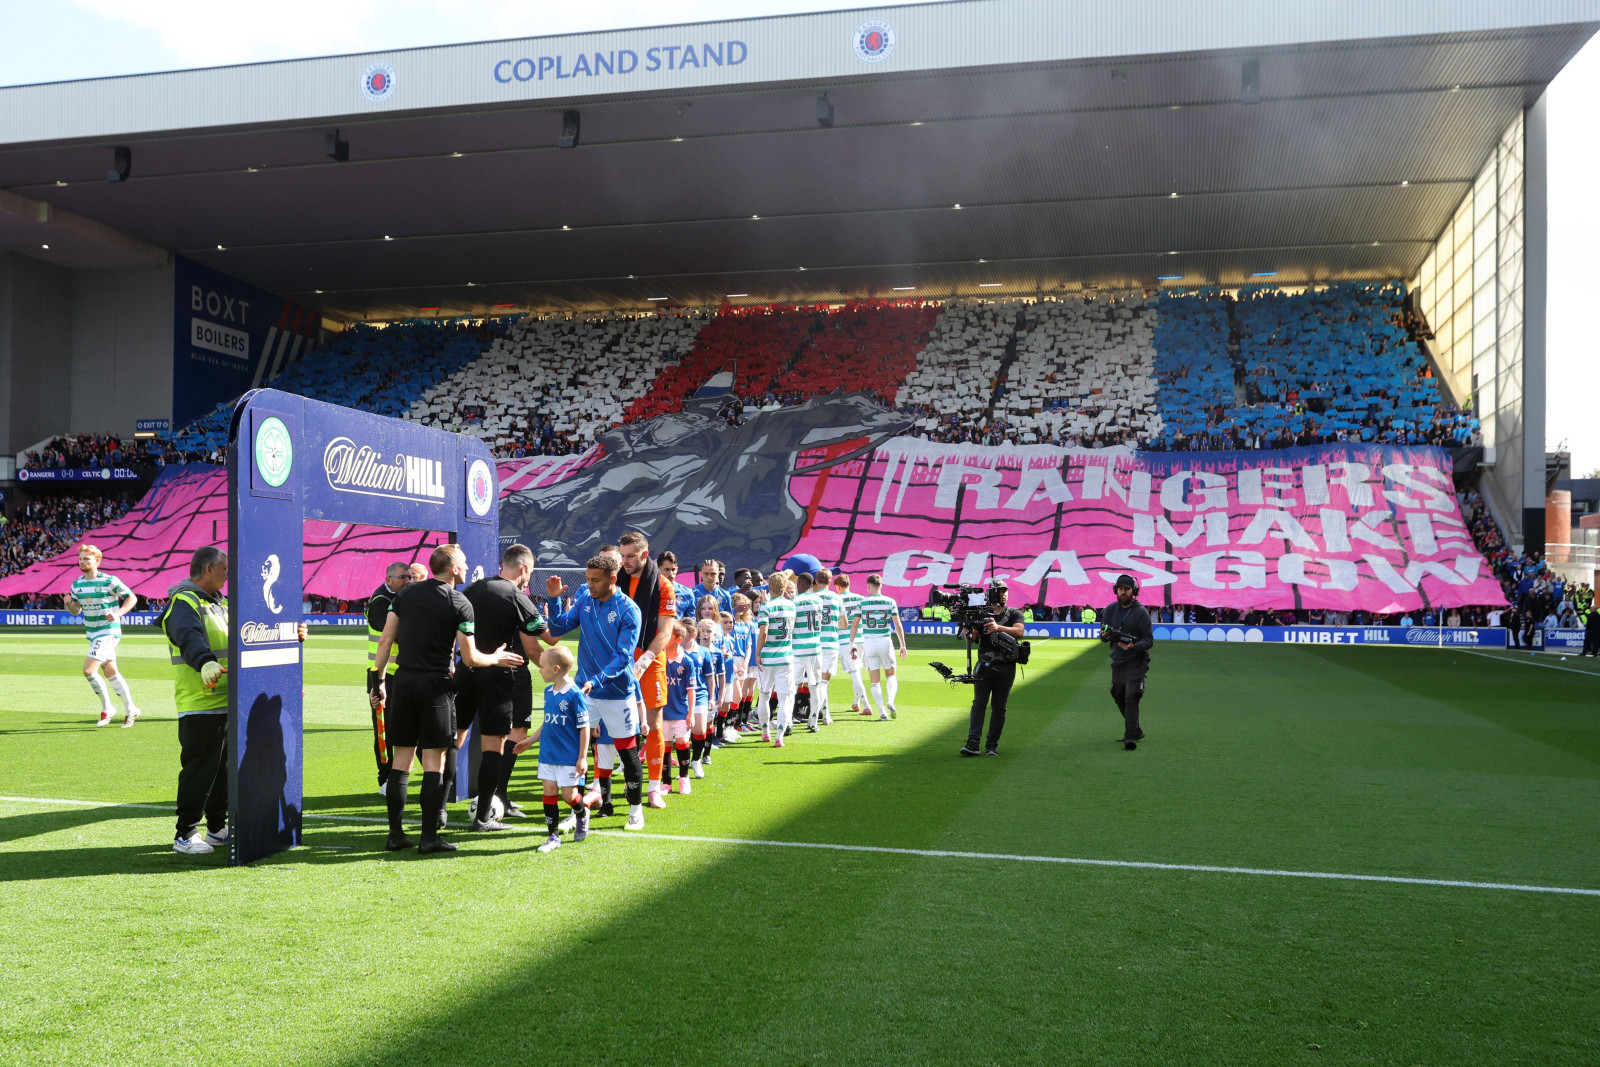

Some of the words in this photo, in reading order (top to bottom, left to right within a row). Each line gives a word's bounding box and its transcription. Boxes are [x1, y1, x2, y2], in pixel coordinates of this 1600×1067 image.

[494, 50, 638, 83] COPLAND
[646, 40, 748, 72] STAND
[191, 285, 249, 325] BOXT
[196, 325, 245, 352] BOILERS
[324, 437, 406, 491] William
[406, 455, 444, 498] HILL
[934, 460, 1455, 512] RANGERS
[1133, 508, 1473, 556] MAKE
[882, 548, 1483, 594] GLASGOW
[7, 614, 55, 625] UNIBET
[866, 610, 888, 628] 63
[1284, 631, 1358, 644] UNIBET
[1364, 629, 1390, 641] HILL
[1556, 631, 1585, 640] Impact
[94, 640, 101, 649] 5
[545, 713, 567, 725] OXT
[624, 707, 631, 724] 2
